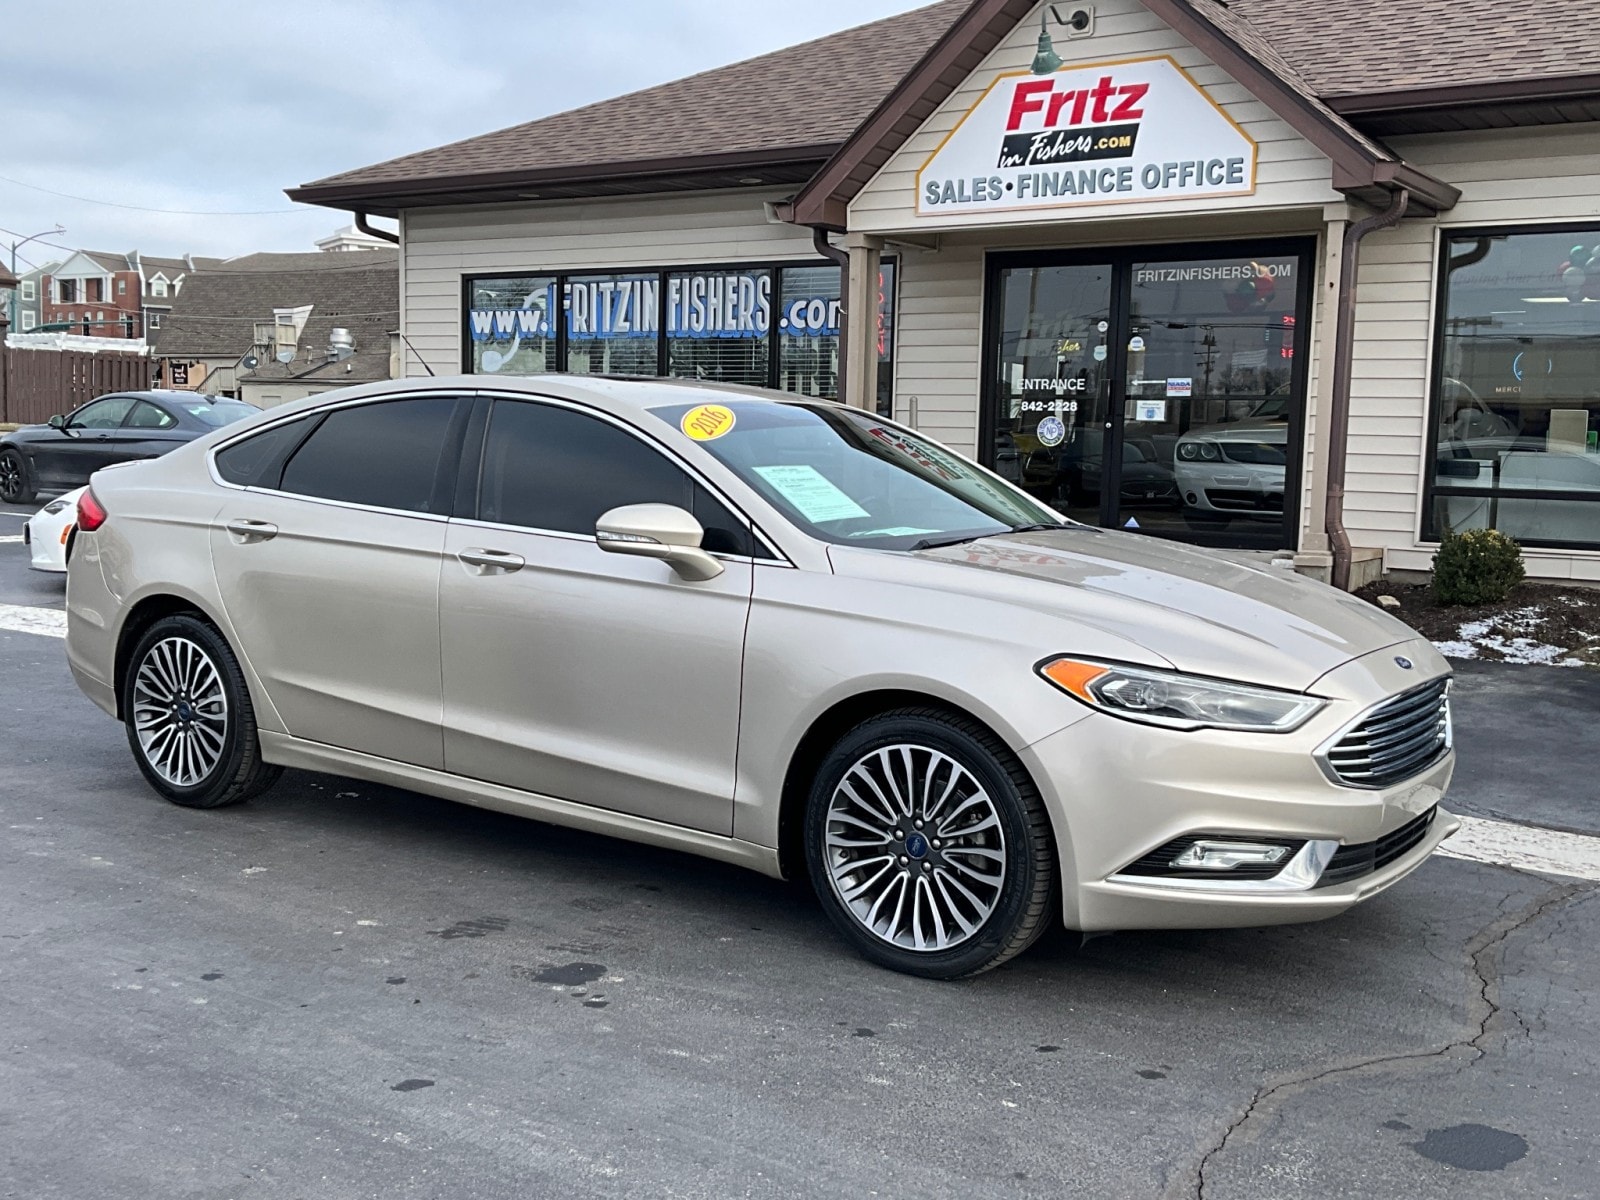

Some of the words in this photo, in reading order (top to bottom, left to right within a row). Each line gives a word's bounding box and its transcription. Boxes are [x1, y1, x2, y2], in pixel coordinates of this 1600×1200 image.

[1006, 76, 1150, 131] Fritz
[1000, 147, 1023, 168] in
[1141, 157, 1244, 190] OFFICE
[1137, 264, 1291, 282] FRITZINFISHERS.COM
[1017, 378, 1086, 390] ENTRANCE
[1021, 401, 1078, 412] 842-2228
[690, 406, 728, 436] 2016
